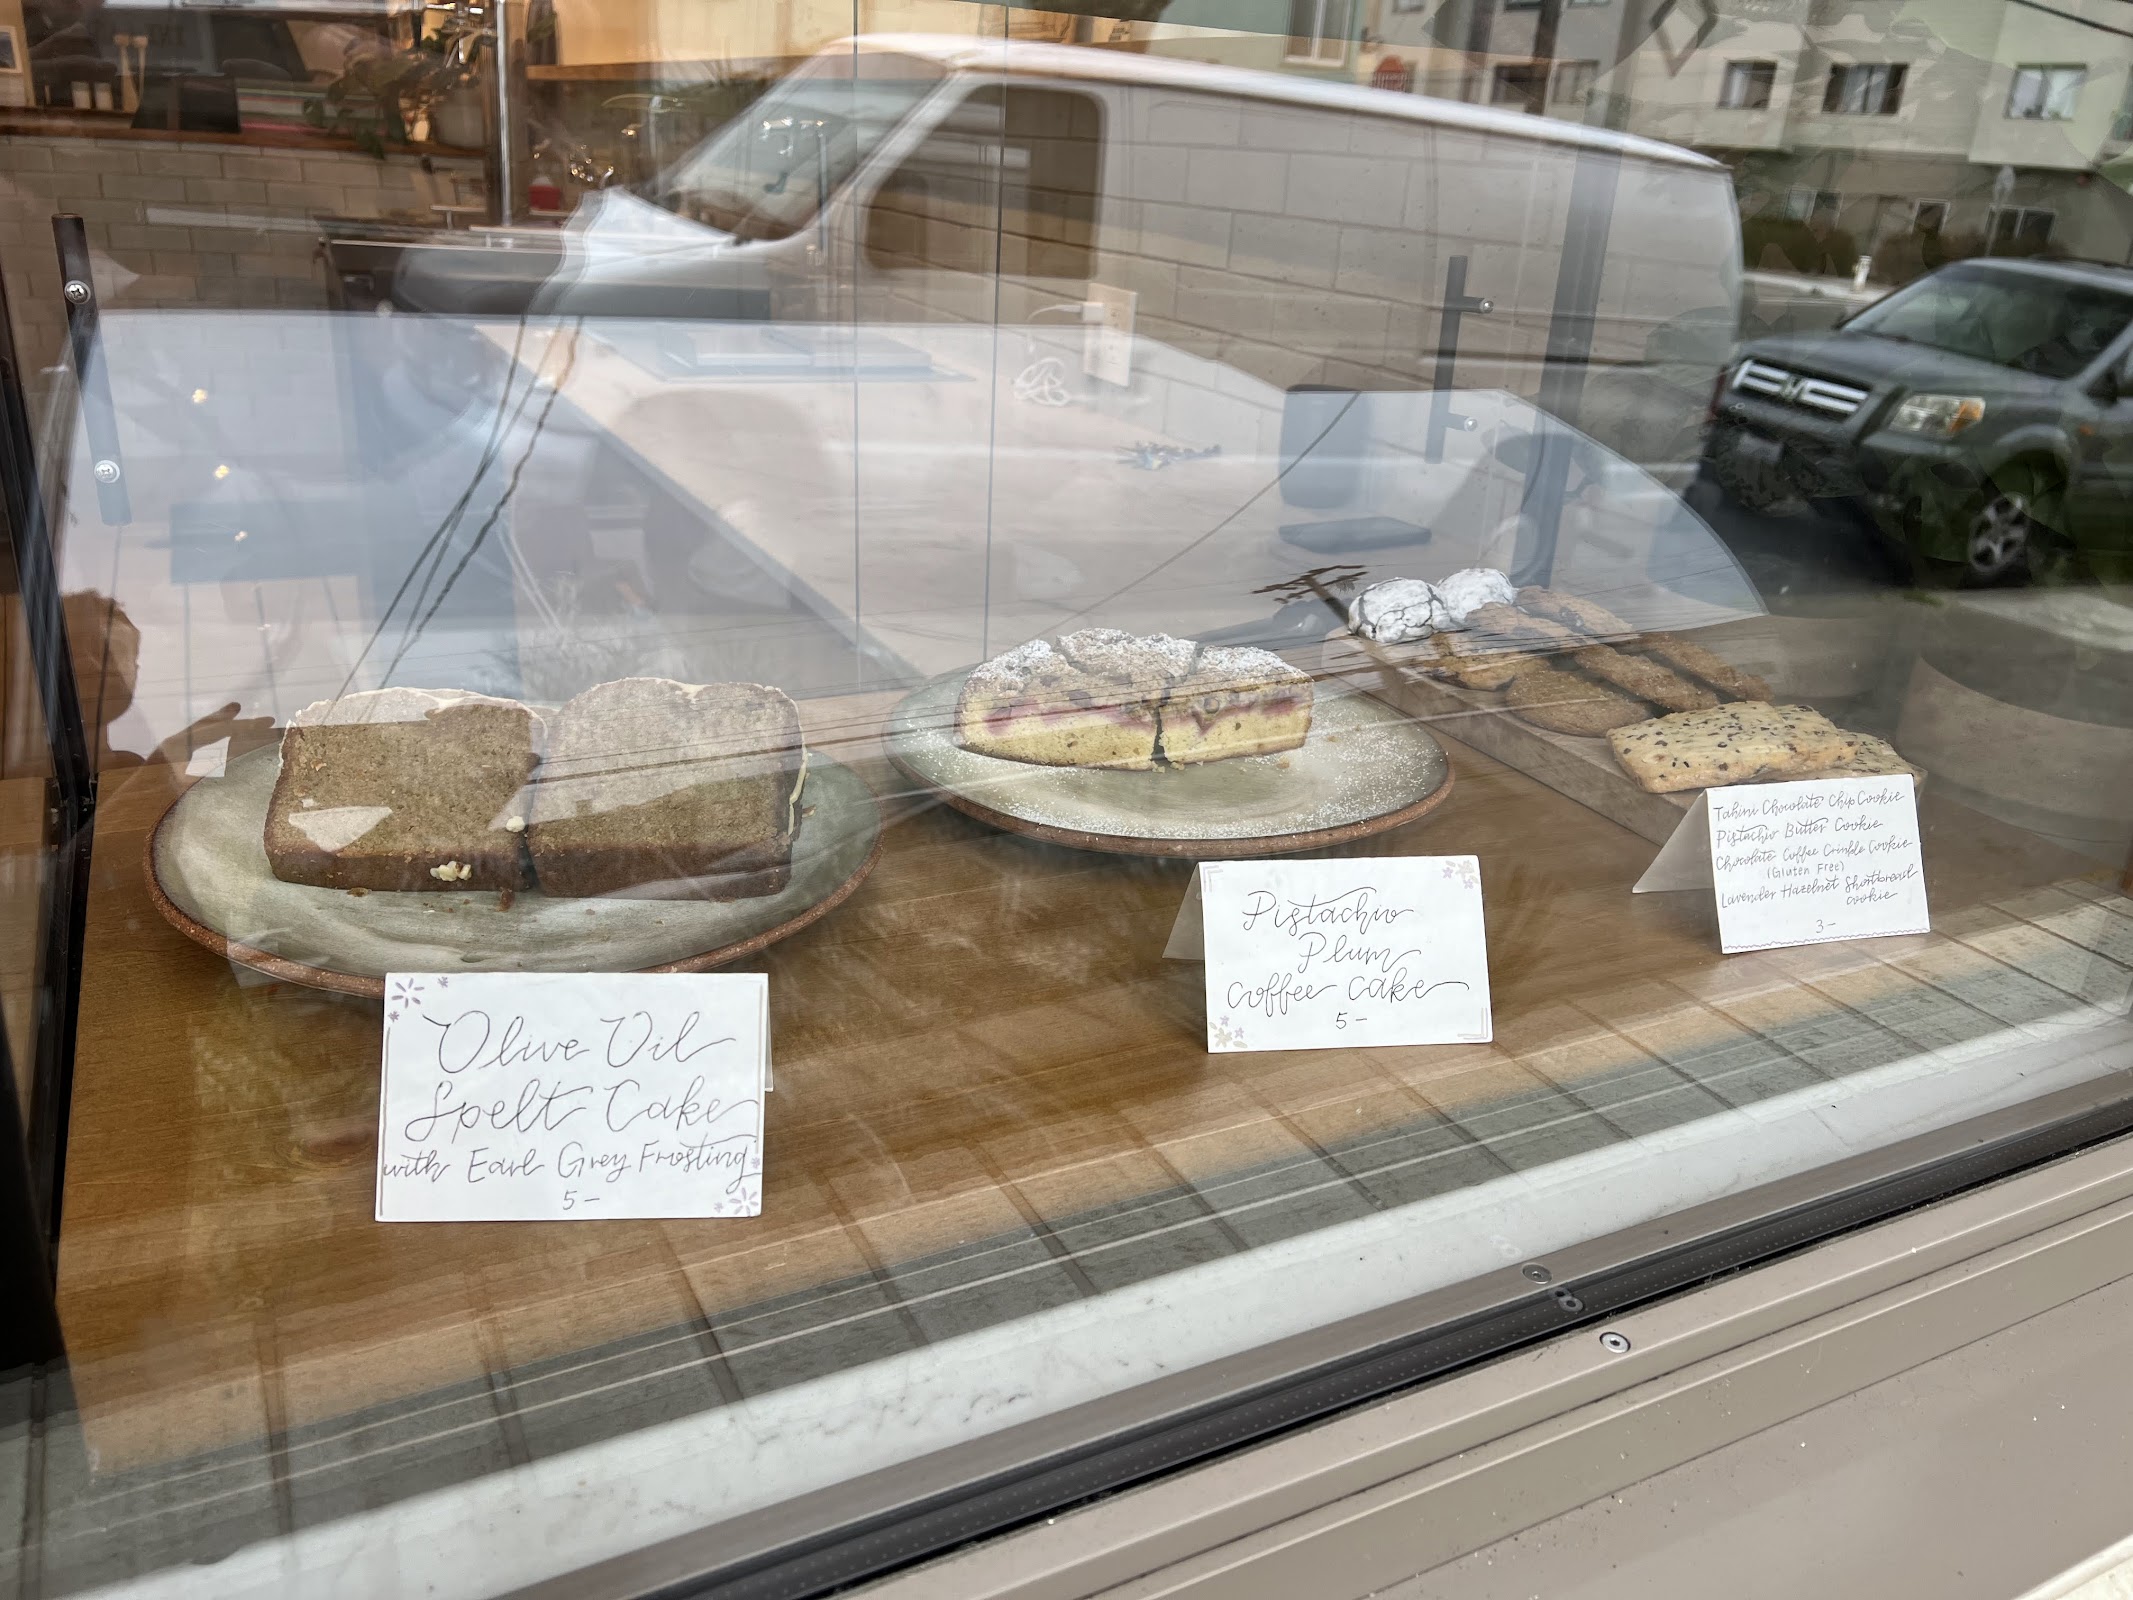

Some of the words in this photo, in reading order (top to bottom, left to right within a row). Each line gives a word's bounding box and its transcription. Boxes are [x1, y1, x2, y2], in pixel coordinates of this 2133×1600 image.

[1713, 802, 1759, 821] Tahini
[1762, 794, 1824, 815] Chocolate
[1829, 790, 1855, 809] Chip
[1858, 788, 1905, 805] Cookie
[1716, 824, 1779, 848] Pistachio
[1785, 817, 1829, 838] Butter
[1835, 815, 1883, 831] Cookie
[1716, 849, 1776, 872] Chocolate
[1783, 846, 1819, 864] Coffee
[1824, 843, 1865, 857] Crinkle
[1869, 835, 1913, 853] Cookie
[1767, 864, 1810, 879] (Gluten
[1817, 862, 1845, 874] Free)
[1721, 886, 1776, 908] Lavender
[1845, 864, 1919, 894] Shortbread
[1242, 886, 1414, 936] Pistachio
[1298, 931, 1422, 974] Plum
[422, 1010, 590, 1074] Olive
[600, 1010, 736, 1068] Oil
[404, 1079, 594, 1144] Spelt
[603, 1075, 760, 1133] Cake
[381, 1149, 451, 1182] with
[467, 1147, 545, 1183] Earl
[558, 1141, 631, 1183] Grey
[639, 1132, 762, 1194] Frosting
